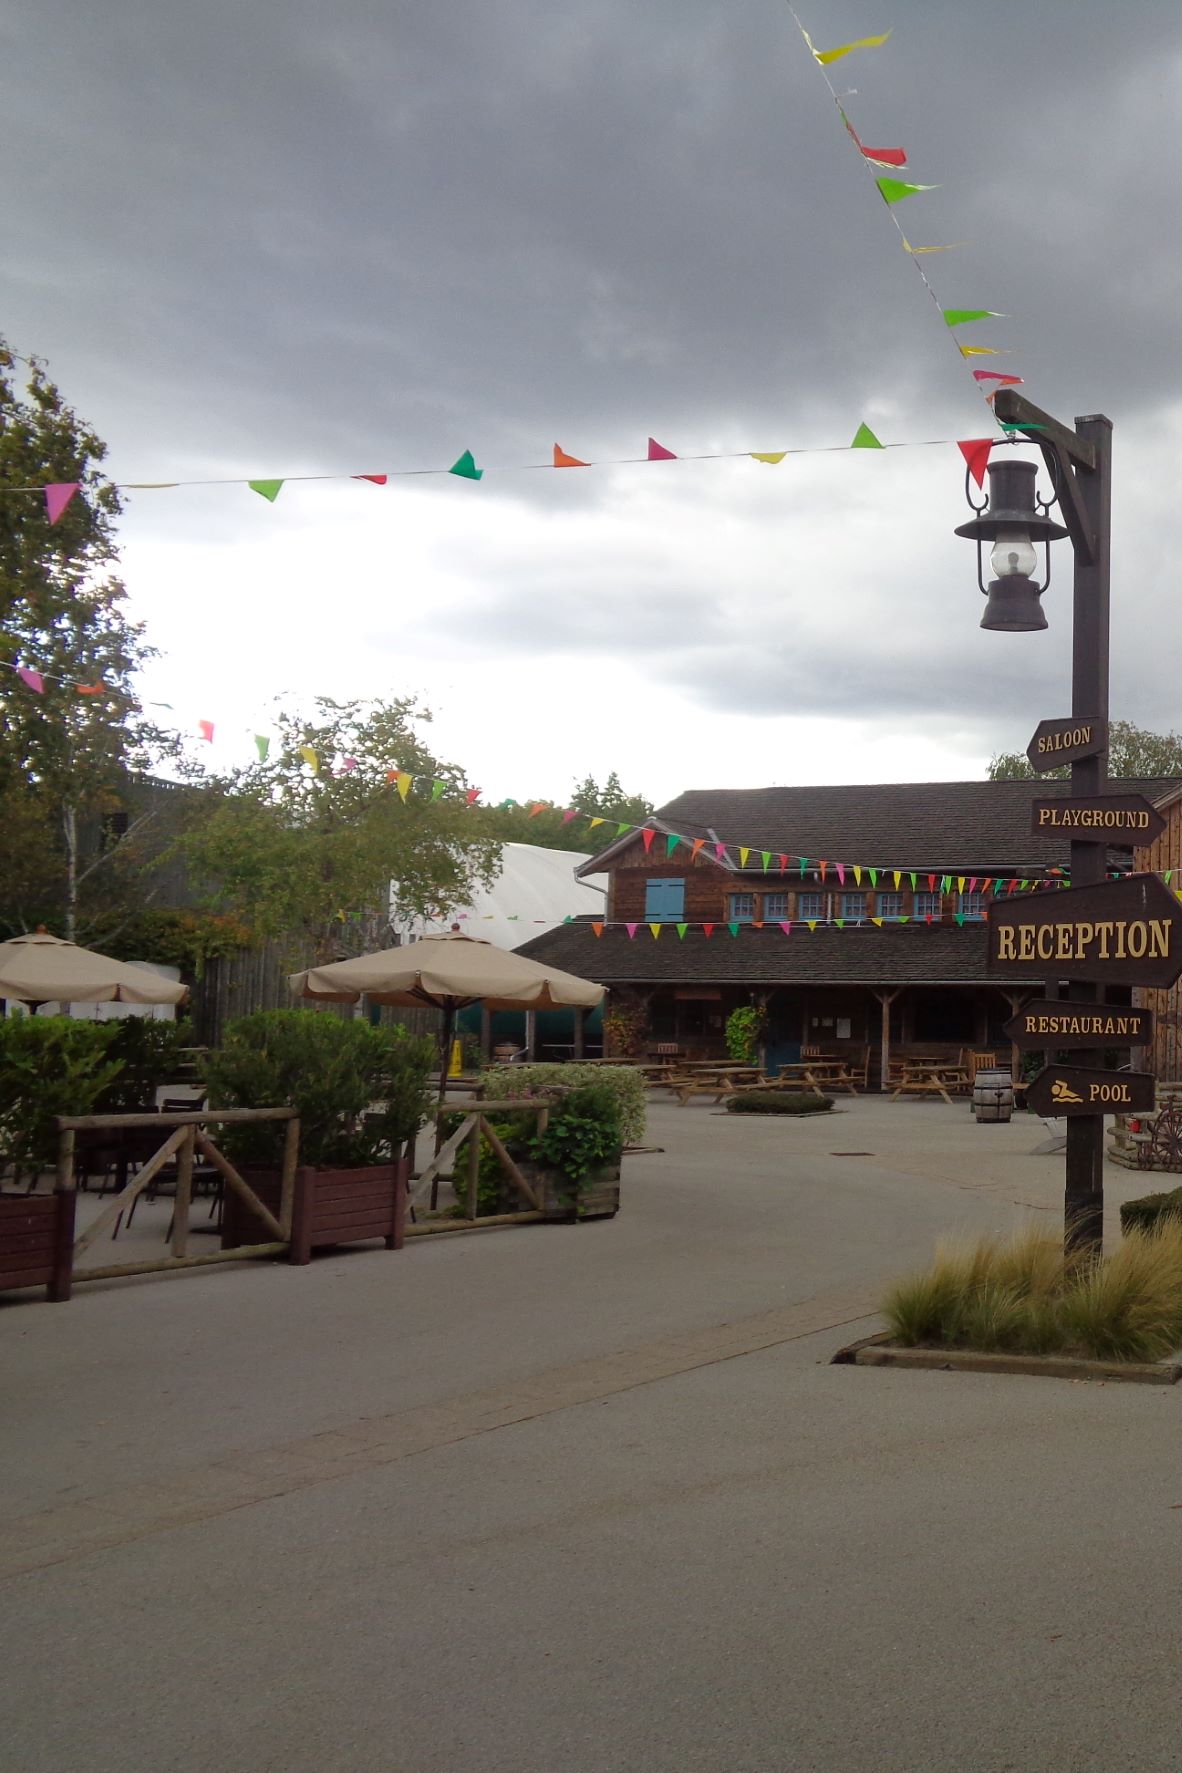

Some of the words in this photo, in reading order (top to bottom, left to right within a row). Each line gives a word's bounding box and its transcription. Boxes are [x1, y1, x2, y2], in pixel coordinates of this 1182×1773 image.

[1038, 727, 1091, 753] SALOON
[1038, 809, 1149, 828] PLAYGROUND
[997, 919, 1172, 961] RECEPTION
[1025, 1015, 1141, 1035] RESTAURANT
[1089, 1084, 1131, 1103] POOL
